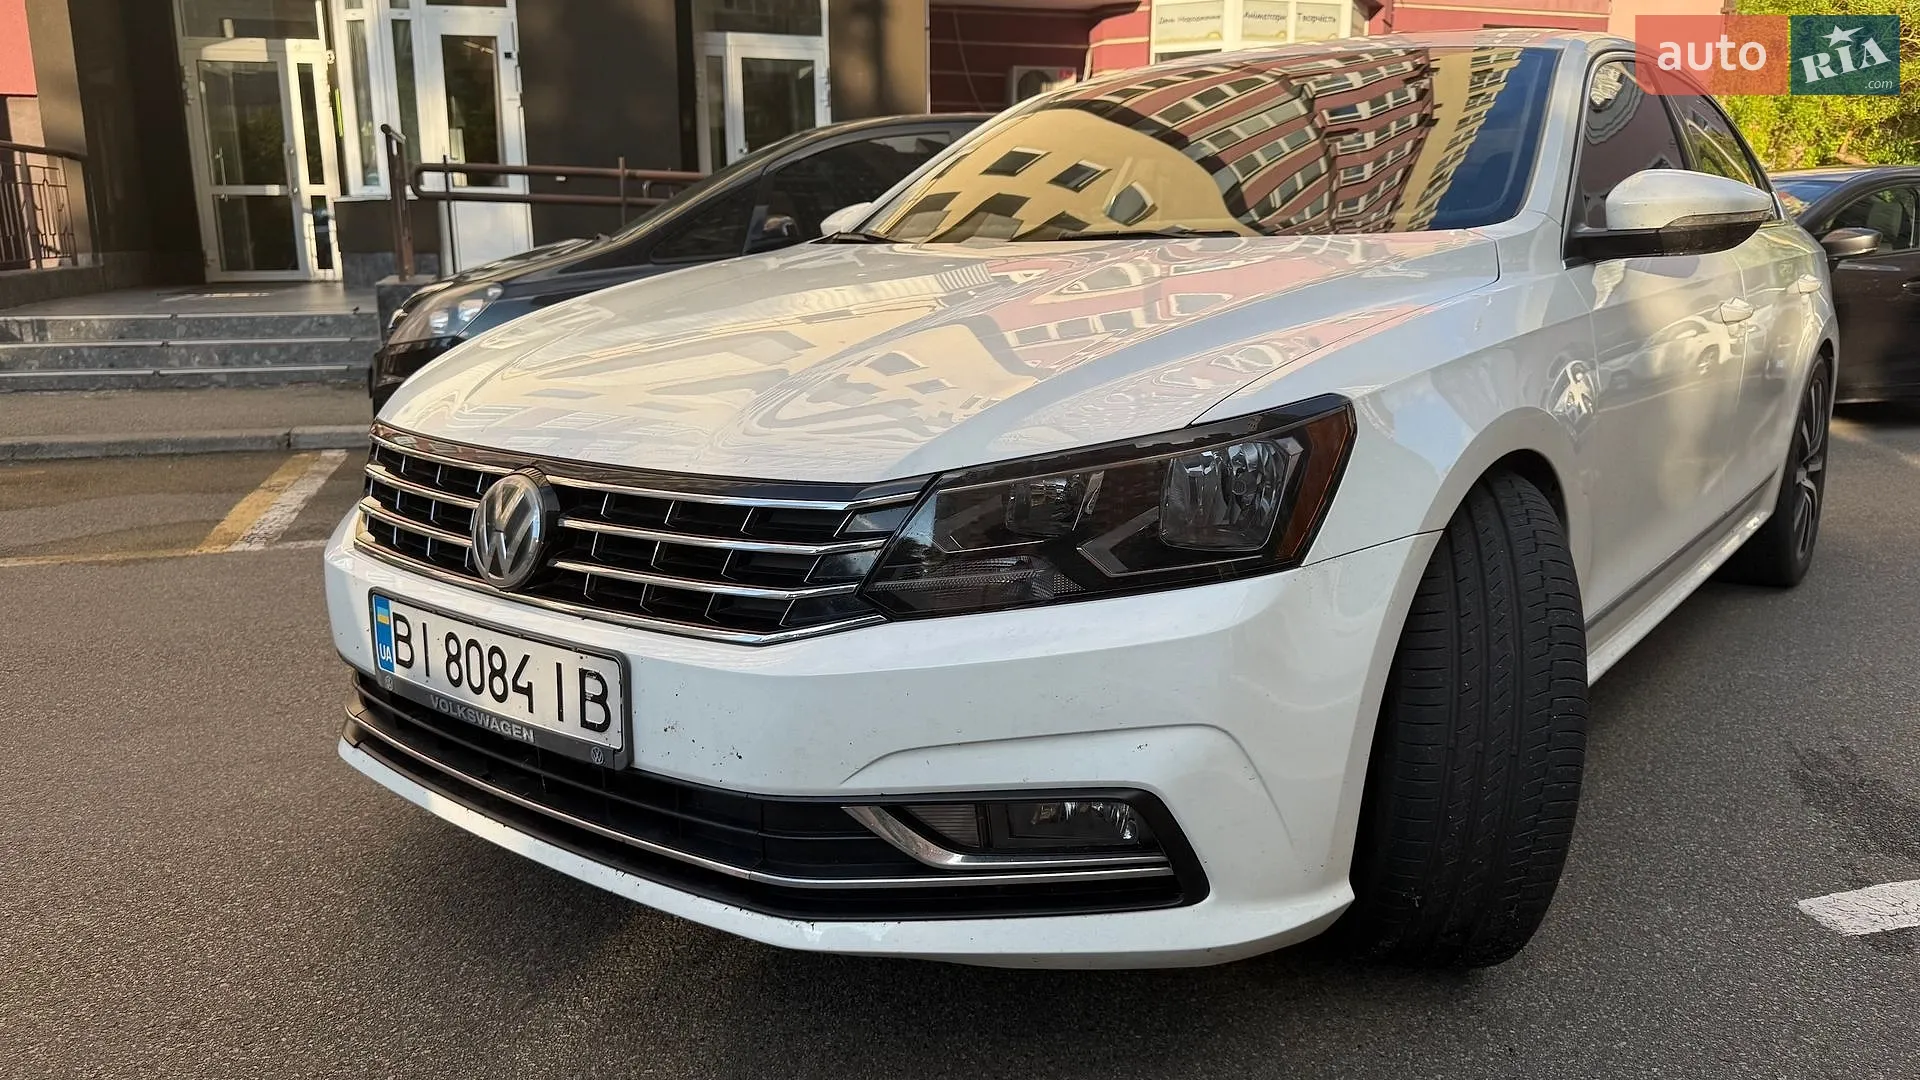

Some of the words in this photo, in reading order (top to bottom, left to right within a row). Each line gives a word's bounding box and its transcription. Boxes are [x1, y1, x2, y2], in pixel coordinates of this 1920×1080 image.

[379, 642, 393, 664] UA
[393, 611, 430, 677] BI
[444, 631, 534, 714] 8084
[555, 661, 612, 733] IB
[430, 694, 536, 744] VOLKSWAGEN
